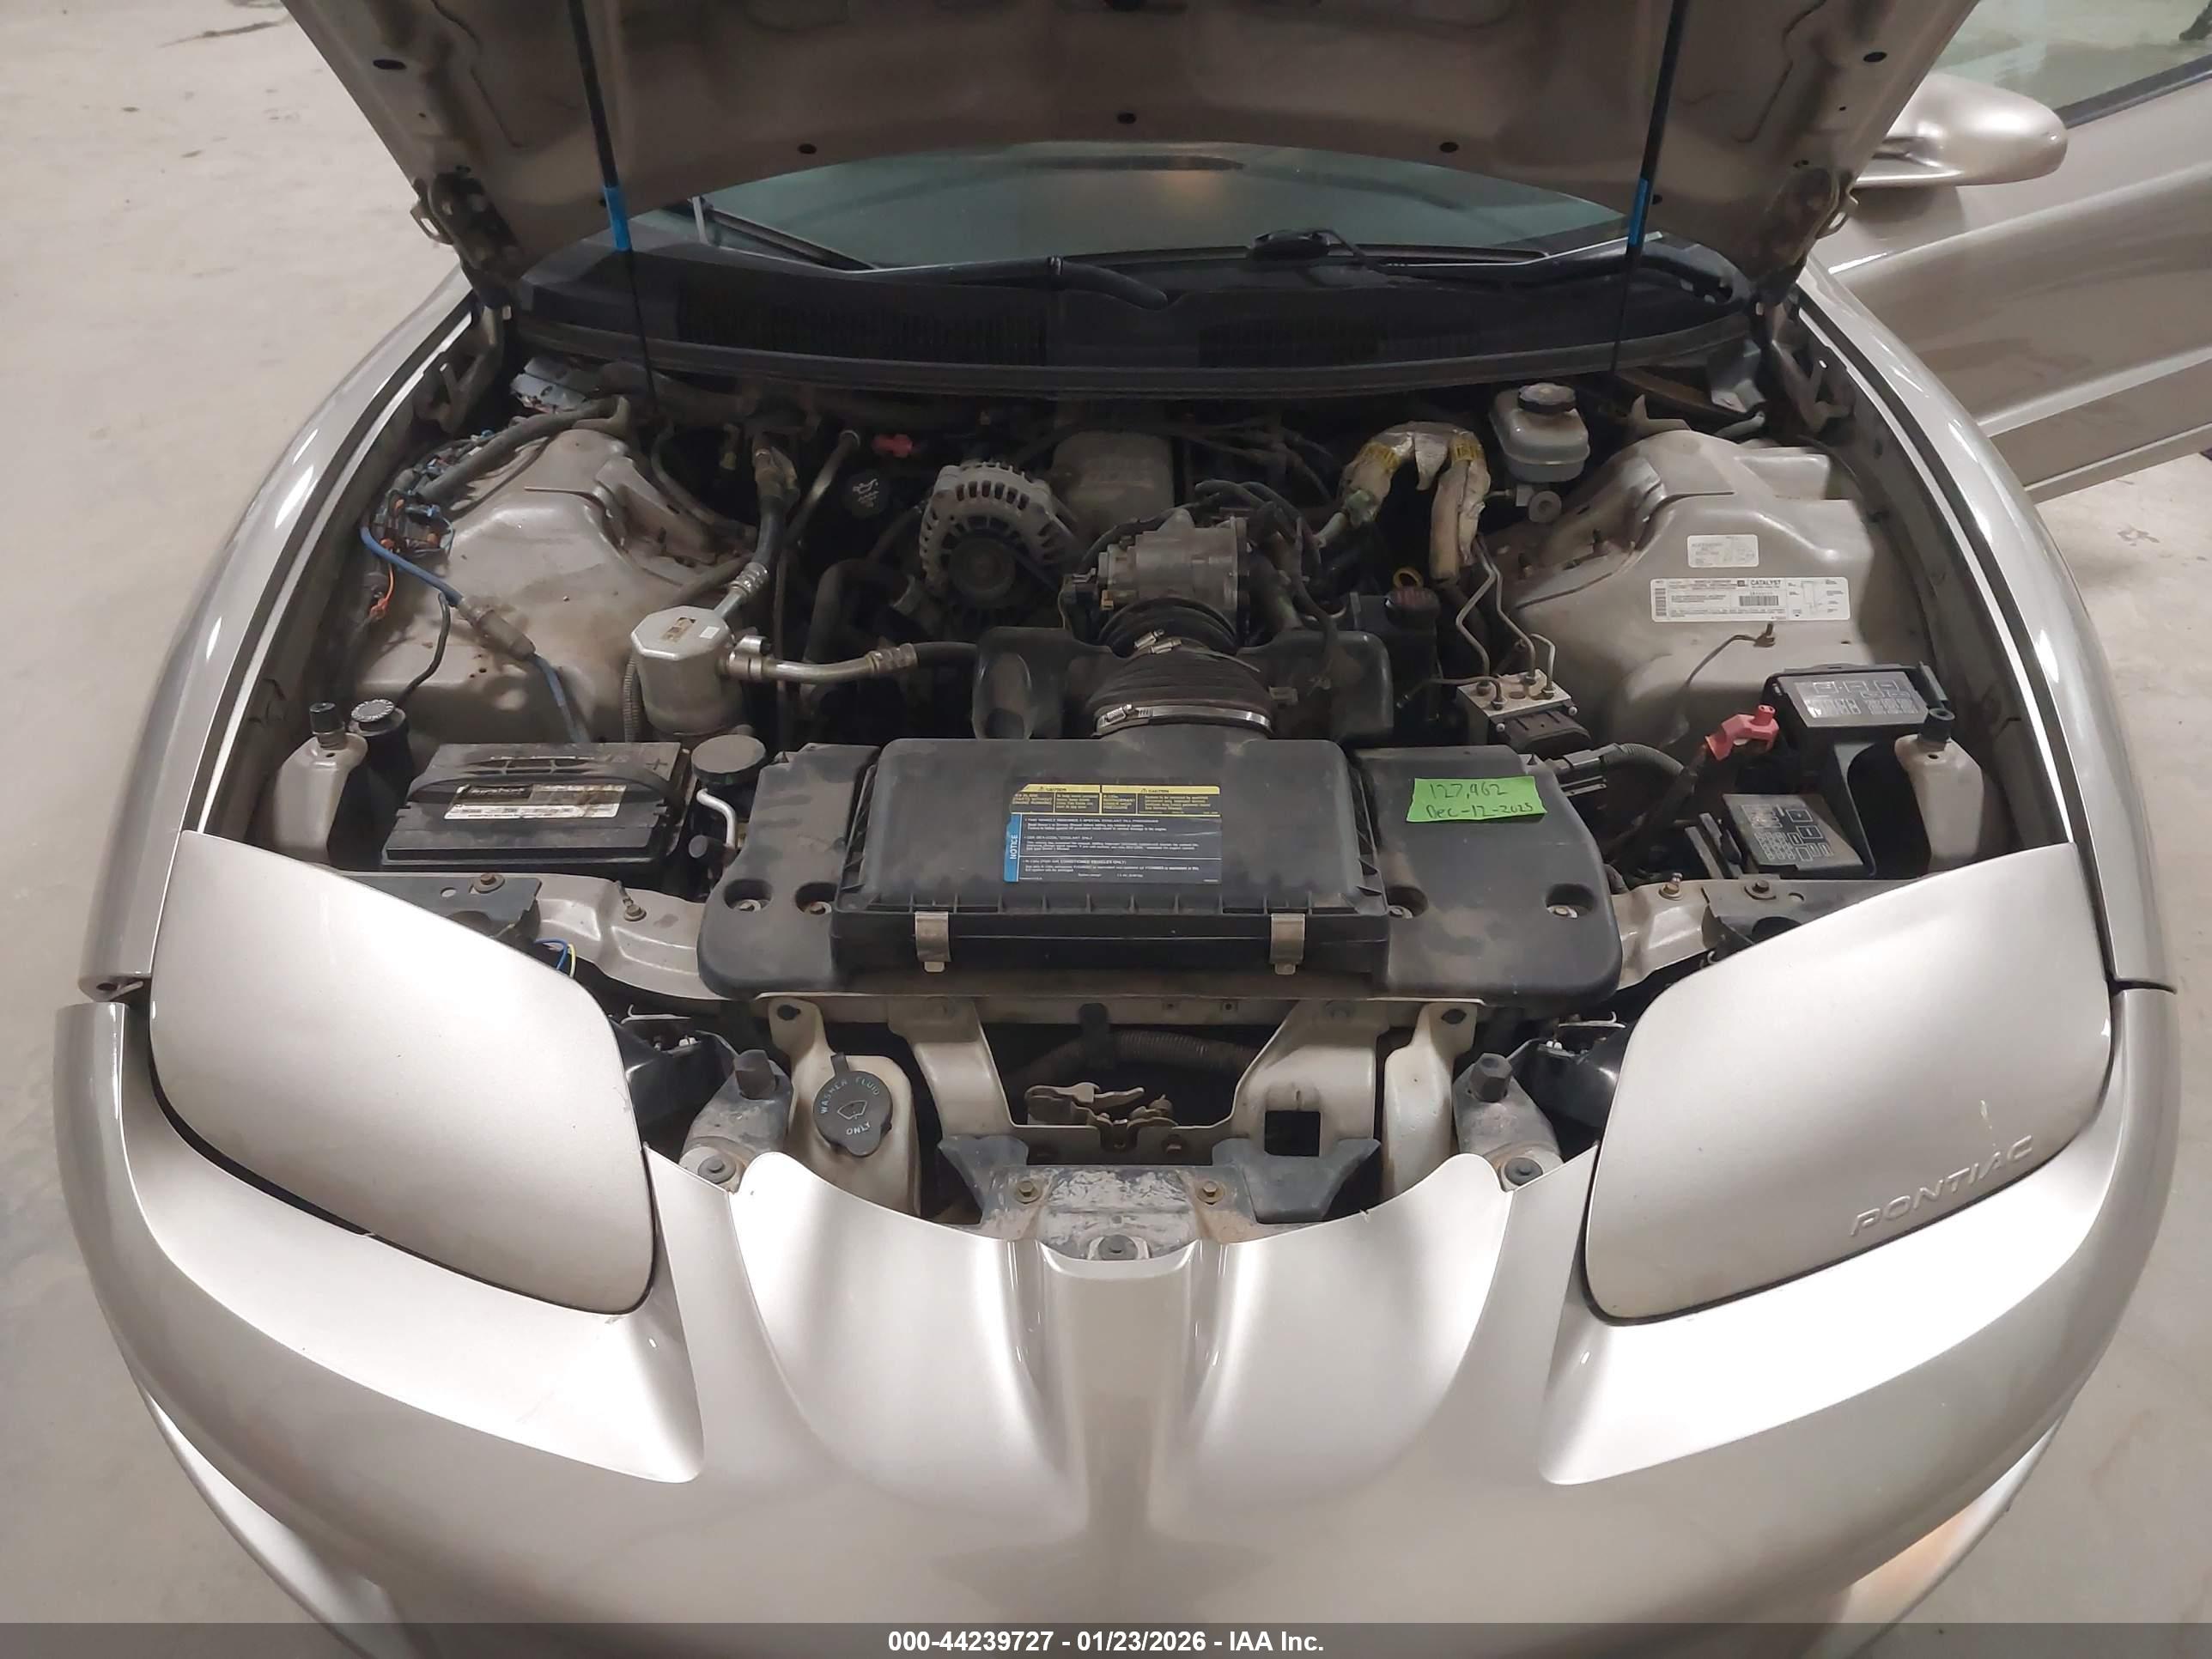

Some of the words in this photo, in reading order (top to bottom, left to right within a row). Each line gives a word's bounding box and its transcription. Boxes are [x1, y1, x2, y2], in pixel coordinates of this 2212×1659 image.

[1009, 834, 1018, 860] NOTICE
[820, 1079, 848, 1115] WASHER
[855, 1077, 880, 1096] FLUID
[846, 1121, 872, 1135] ONLY
[1850, 1133, 2033, 1237] PONTIAC
